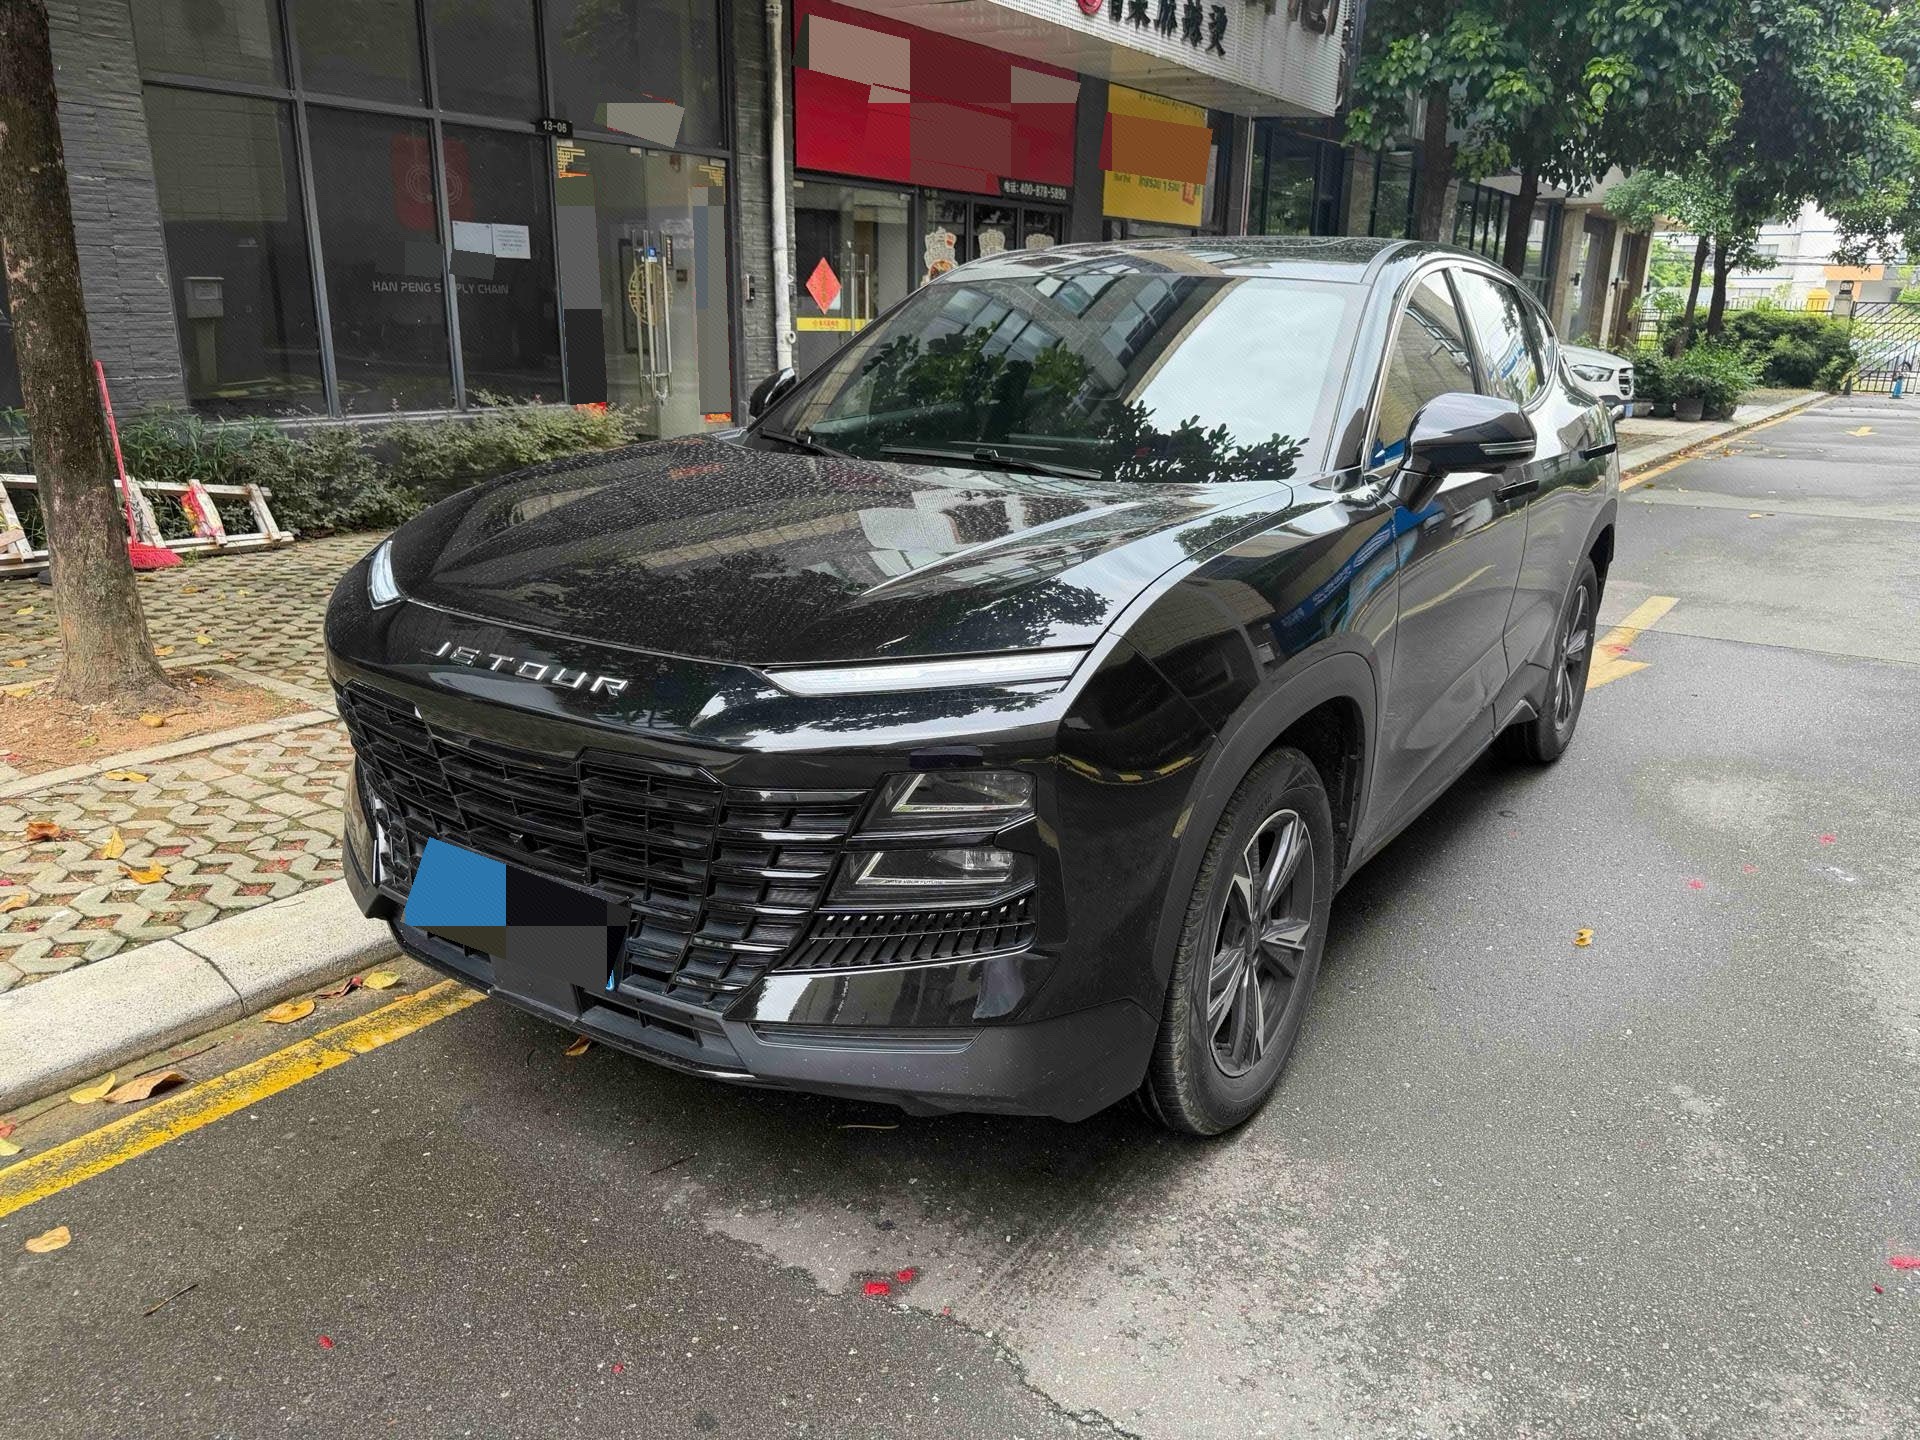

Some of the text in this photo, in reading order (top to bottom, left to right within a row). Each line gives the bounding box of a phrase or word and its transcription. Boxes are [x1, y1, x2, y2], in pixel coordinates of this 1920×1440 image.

[372, 280, 509, 295] HAN PENG SPLY CHAIN
[421, 641, 629, 697] JETOUR
